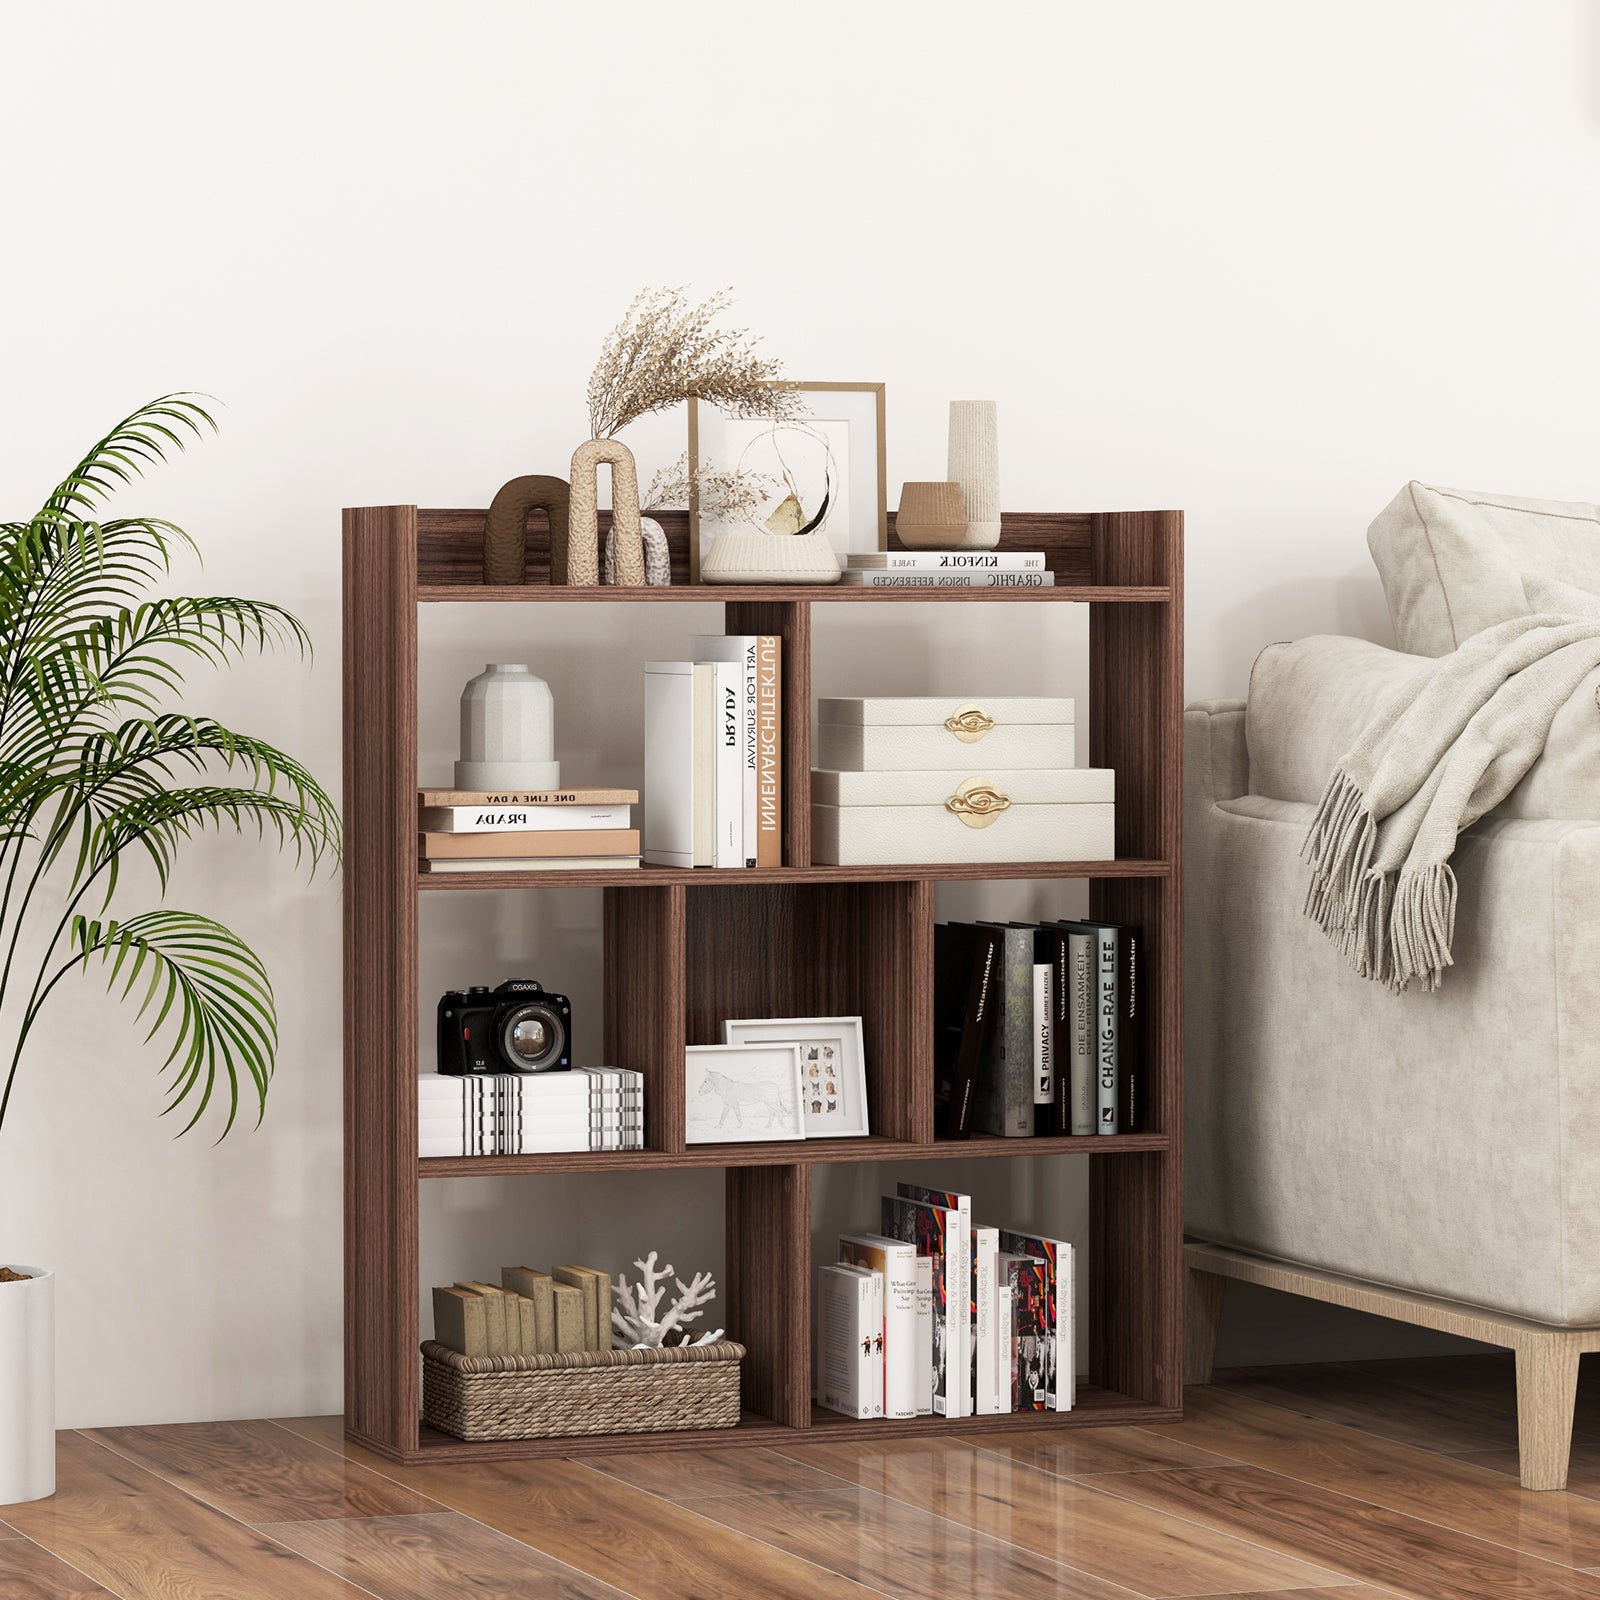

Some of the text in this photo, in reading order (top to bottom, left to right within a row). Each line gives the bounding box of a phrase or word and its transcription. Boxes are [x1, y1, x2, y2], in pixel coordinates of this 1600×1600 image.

[512, 983, 537, 991] CGAXIS
[1077, 952, 1086, 1056] DIE EINSAMKEIT
[1102, 941, 1114, 1089] CHANG-RAE LEE
[1041, 1024, 1050, 1071] PRIVACY
